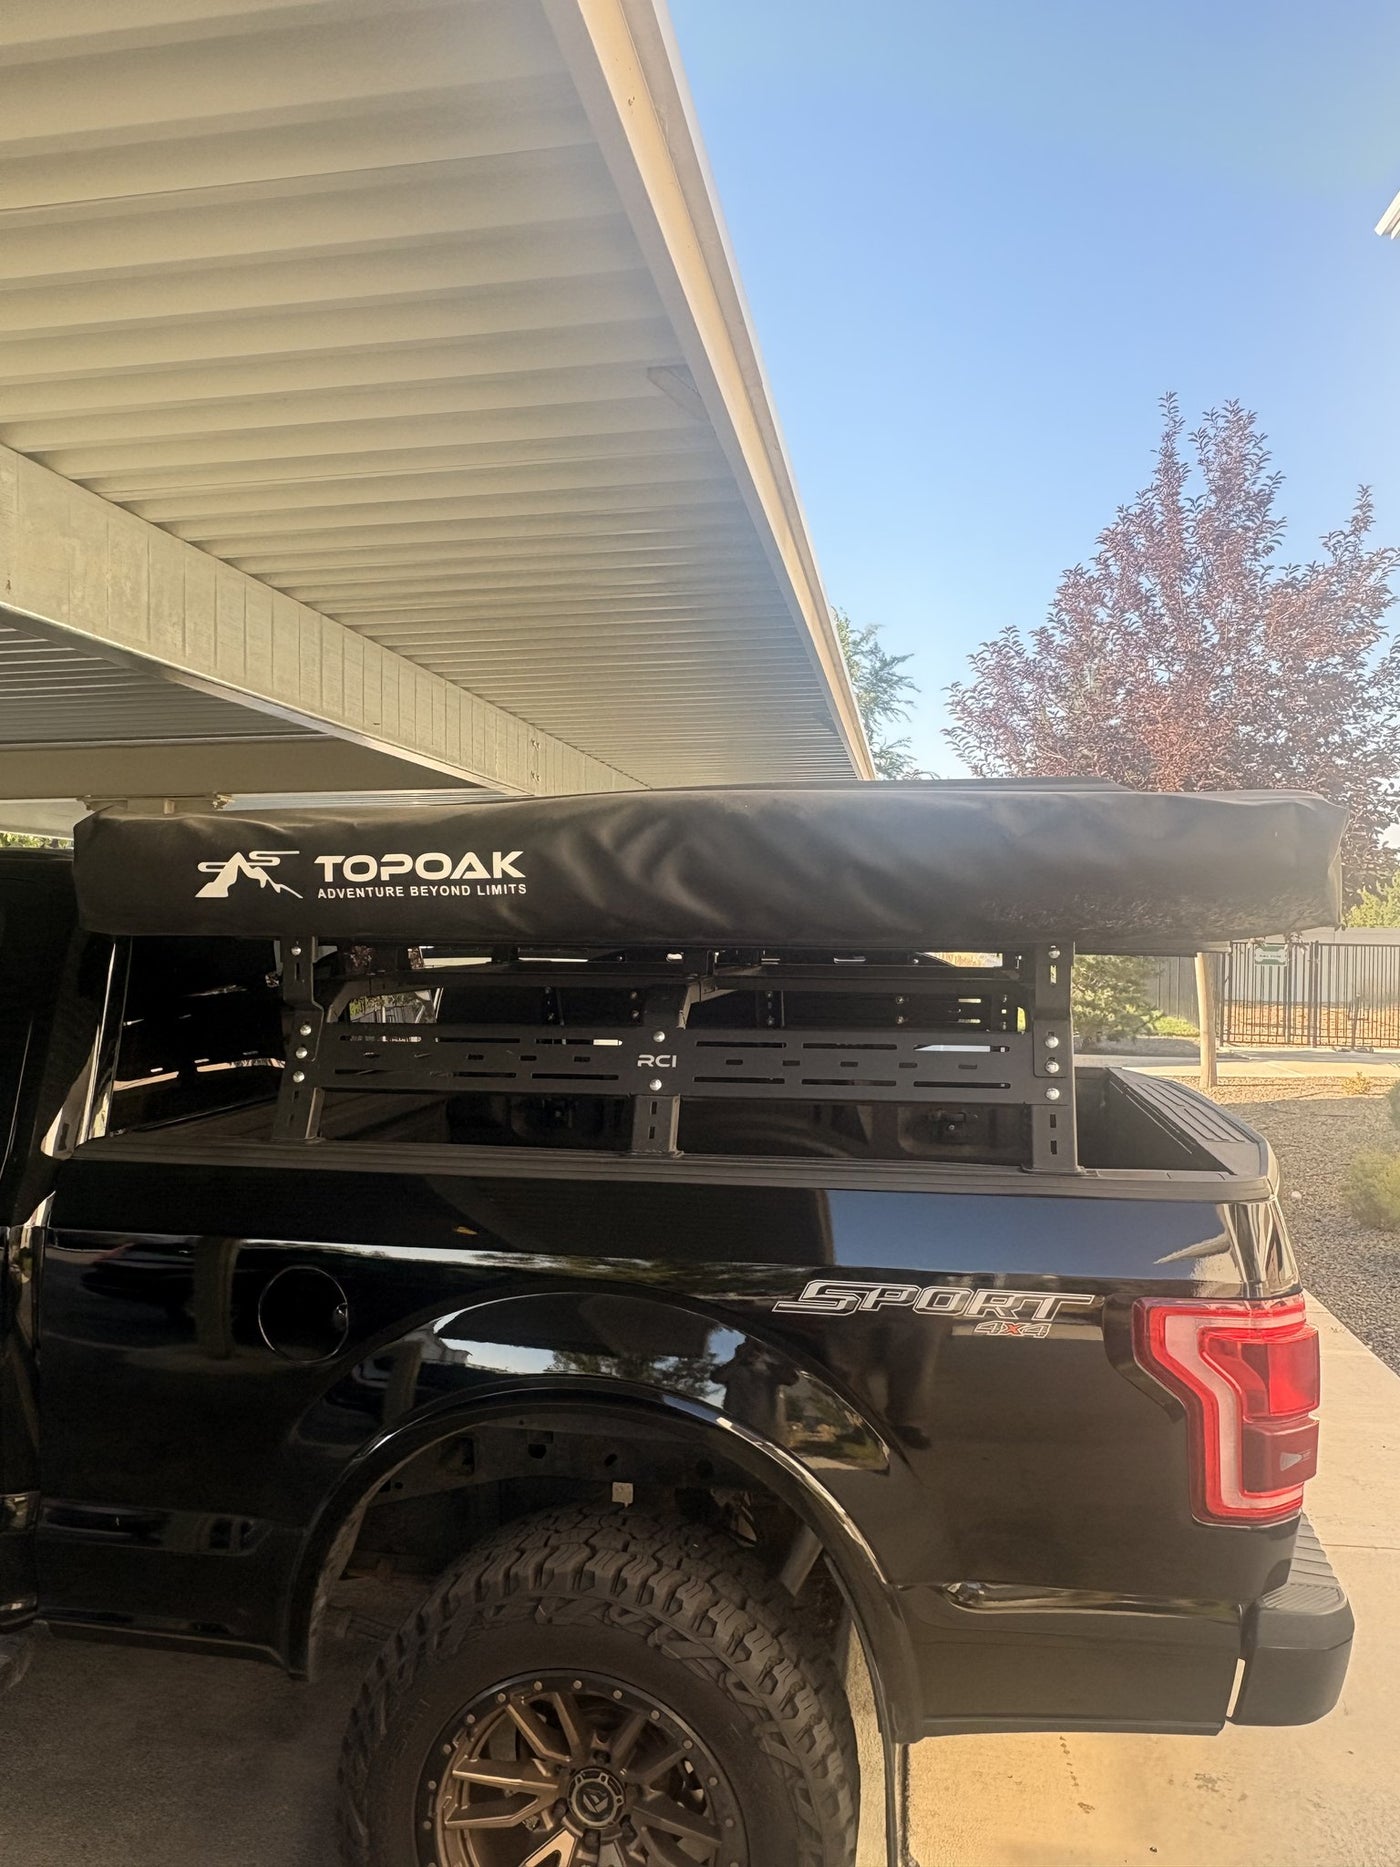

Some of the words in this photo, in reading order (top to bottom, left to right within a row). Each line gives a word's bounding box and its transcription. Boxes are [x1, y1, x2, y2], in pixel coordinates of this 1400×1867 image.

[314, 851, 526, 882] TOPOAK
[317, 886, 404, 899] ADVENTURE
[411, 884, 471, 897] BEYOND
[477, 883, 527, 896] LIMITS
[637, 1054, 677, 1068] RCI
[772, 1279, 1095, 1322] SPORT
